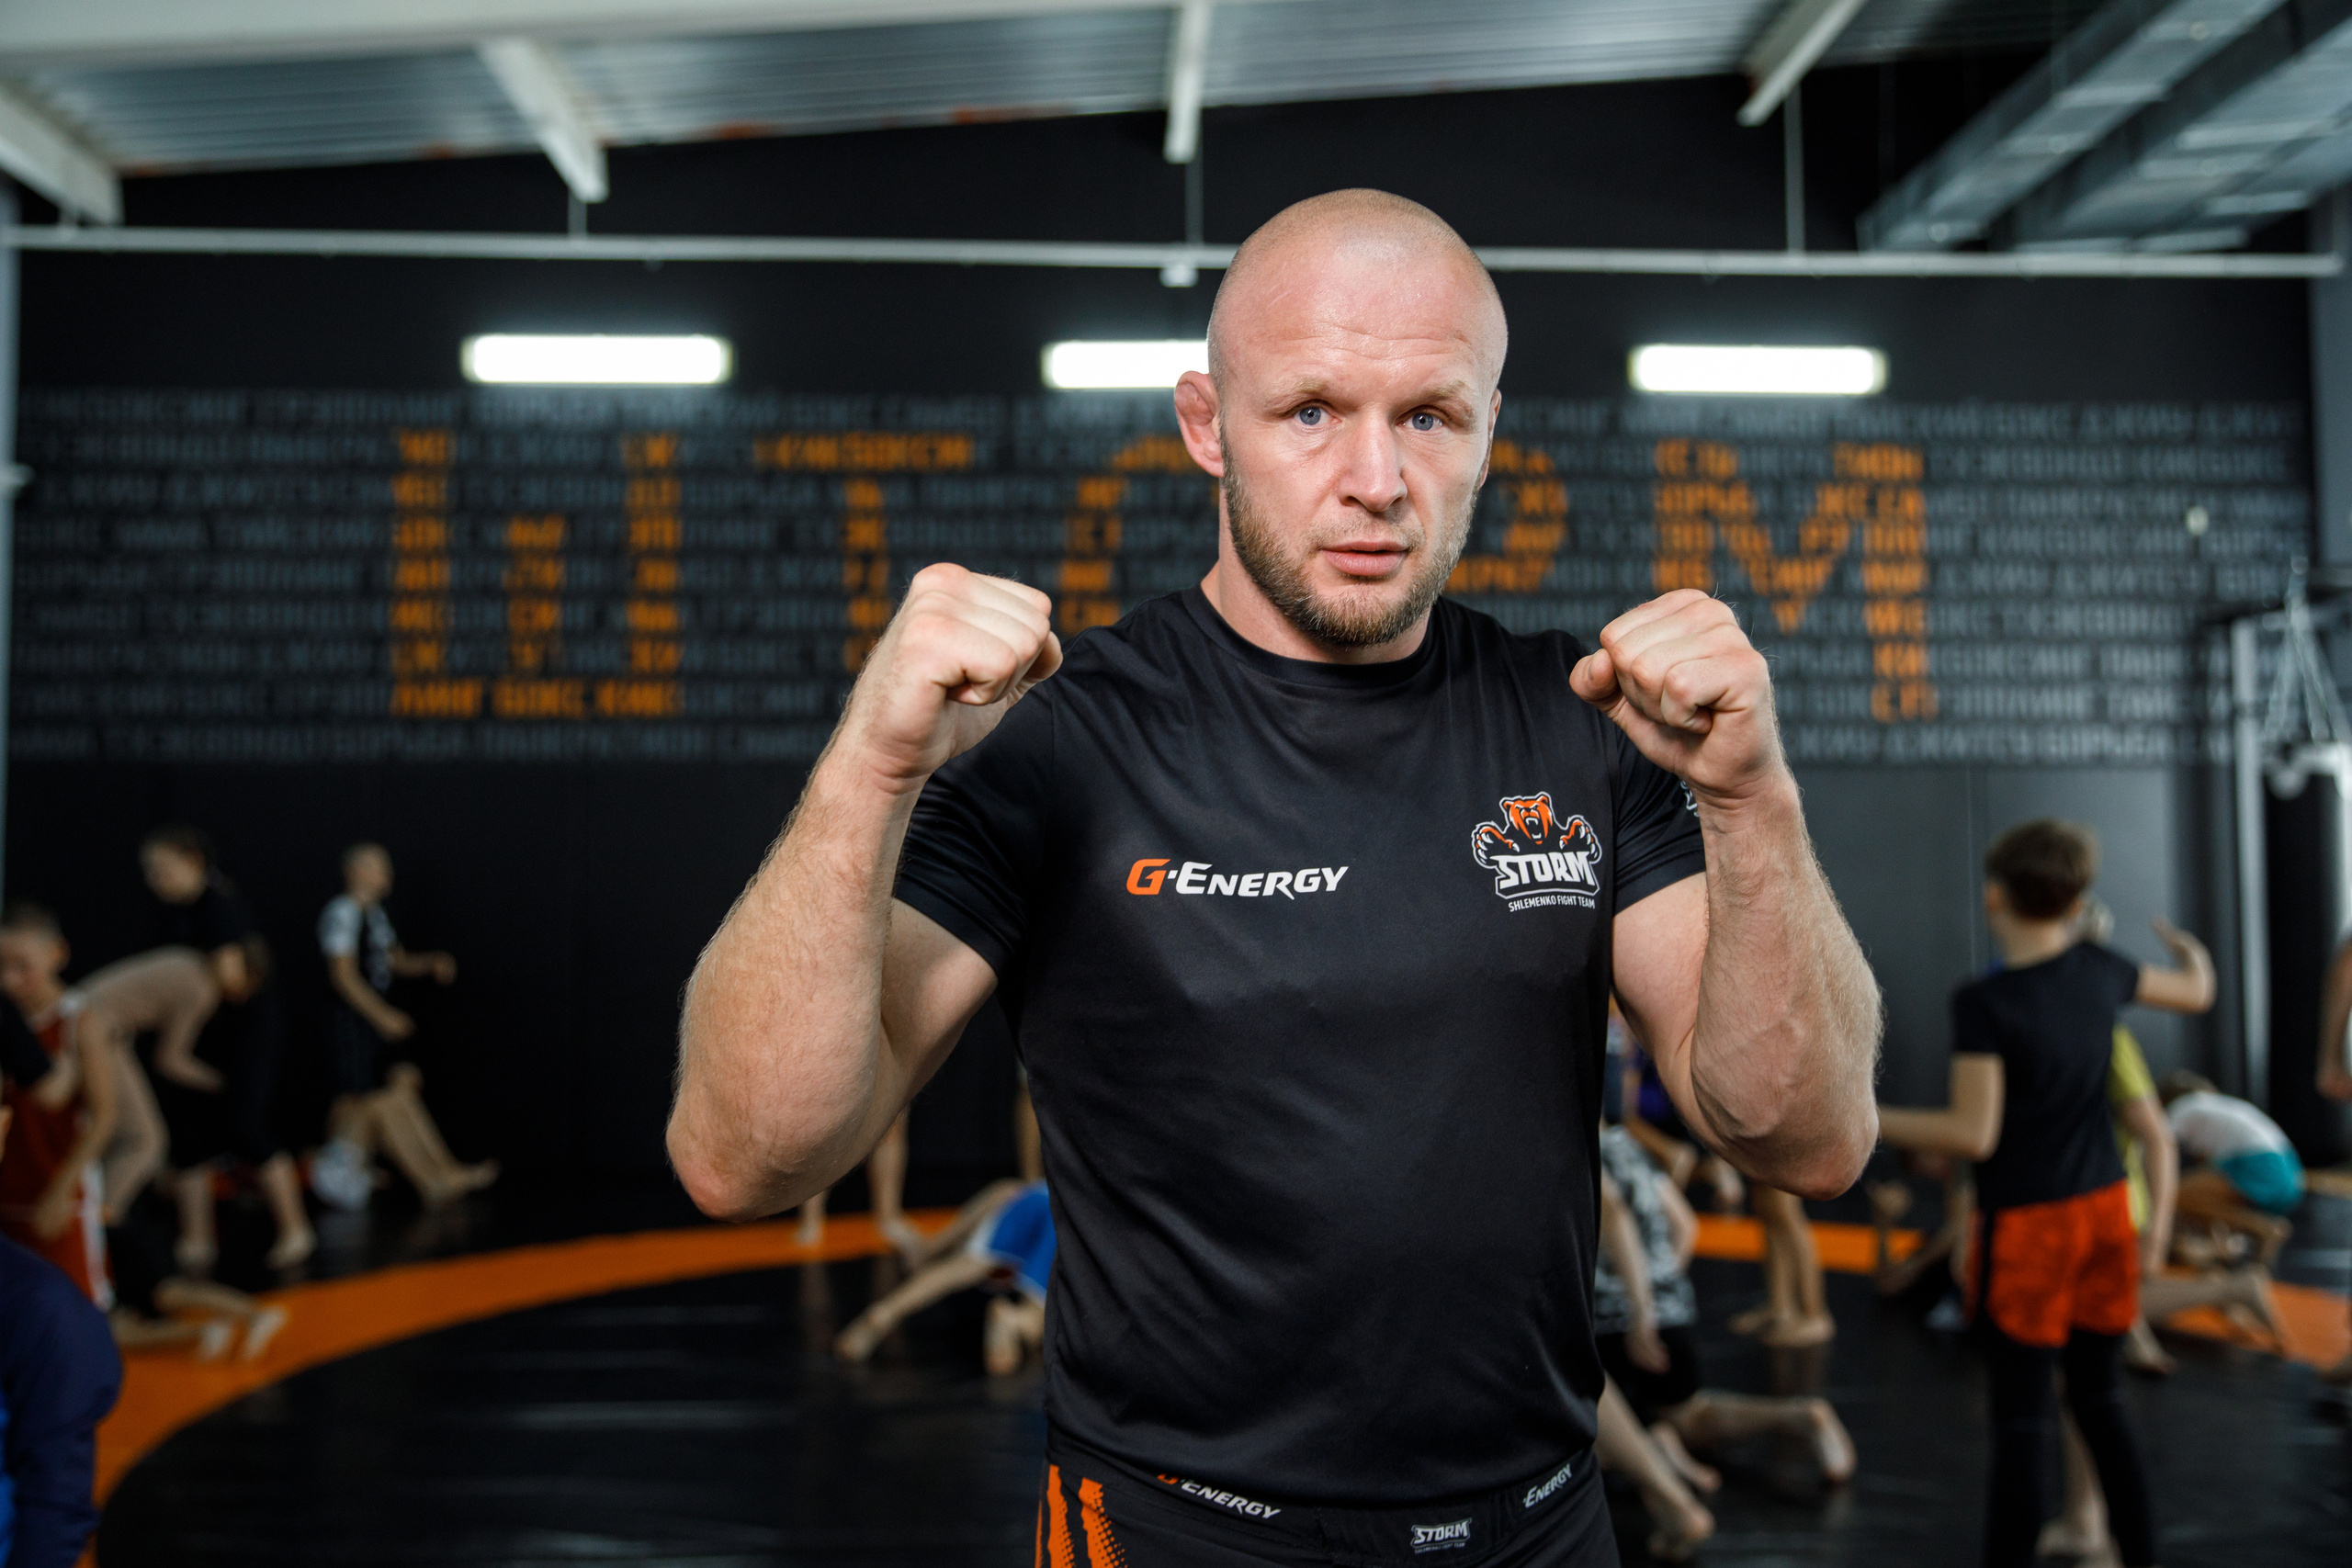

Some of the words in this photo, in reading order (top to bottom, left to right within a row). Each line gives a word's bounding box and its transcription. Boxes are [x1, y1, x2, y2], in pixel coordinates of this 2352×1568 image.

[1489, 852, 1595, 889] STORM
[1508, 896, 1556, 912] SHLEMENKO
[1557, 895, 1577, 906] FIGHT
[1577, 896, 1595, 909] TEAM
[1414, 1521, 1469, 1545] STORM
